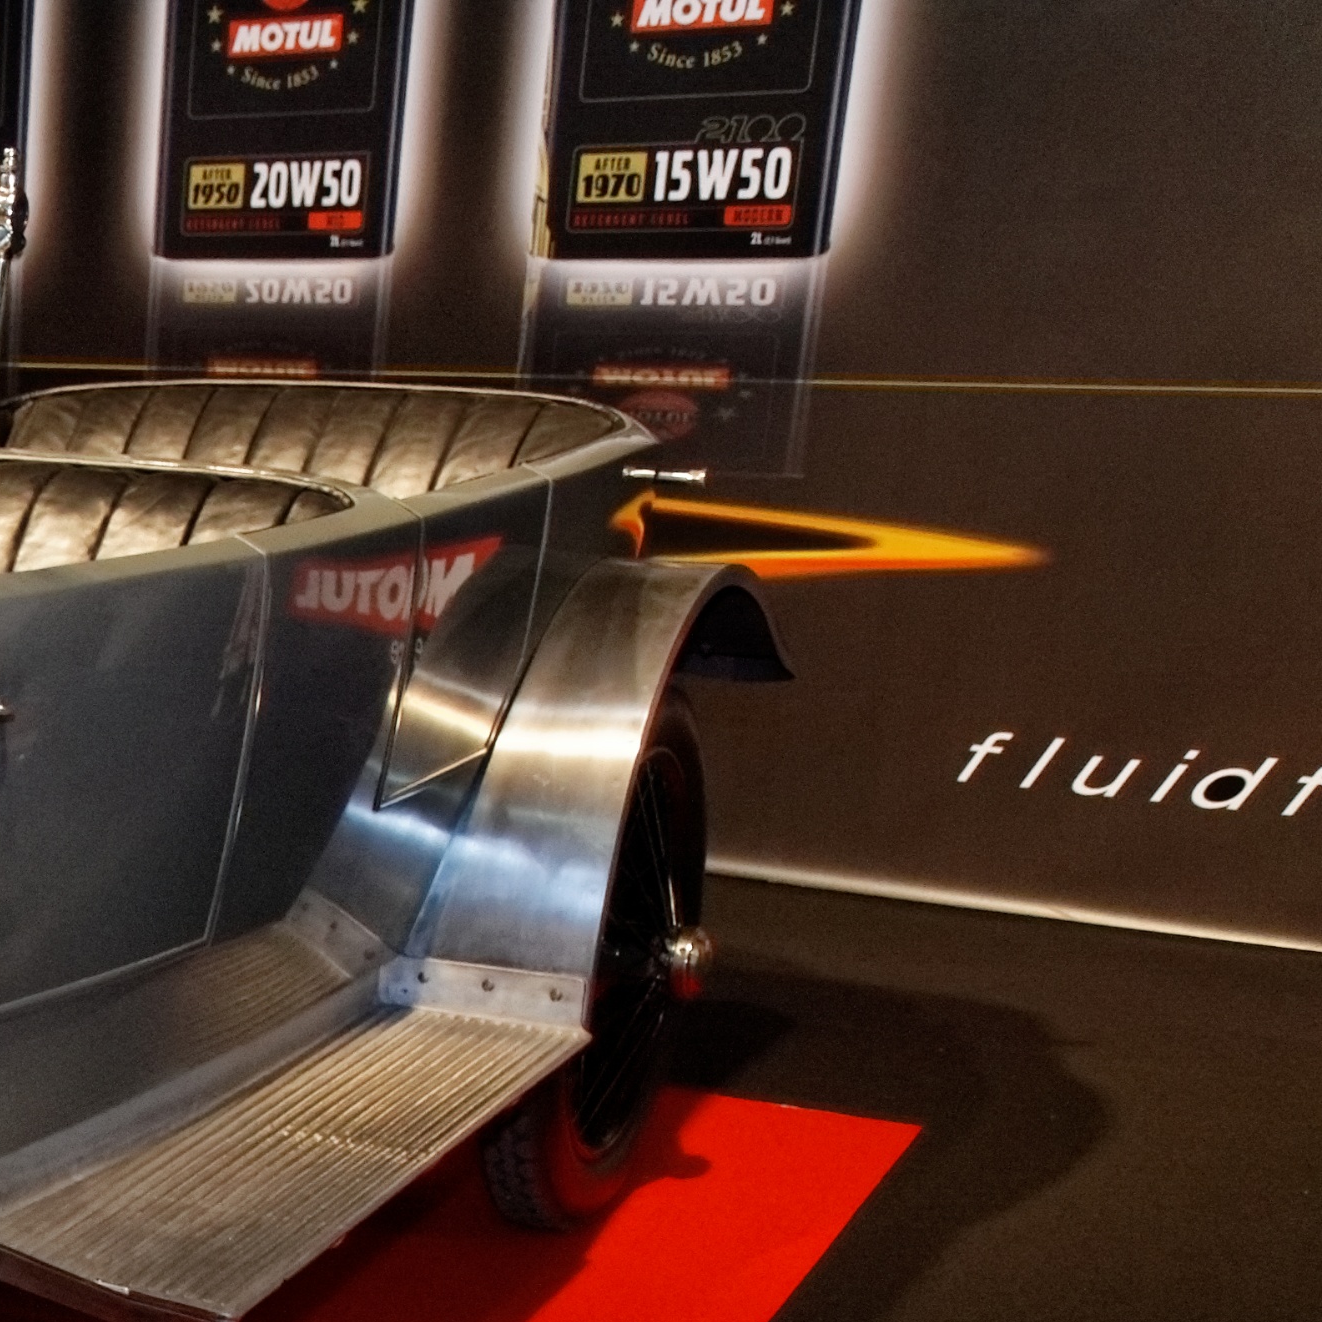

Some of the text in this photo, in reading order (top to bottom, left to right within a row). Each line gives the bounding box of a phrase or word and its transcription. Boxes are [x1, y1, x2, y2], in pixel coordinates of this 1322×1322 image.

[636, 0, 766, 28] MOTUL
[231, 19, 337, 53] MOTUL
[646, 40, 744, 69] Since 1853
[241, 64, 320, 91] Since 1853
[202, 168, 232, 181] AFTER
[594, 157, 630, 171] AFTER
[654, 147, 793, 202] 15W50
[193, 183, 240, 205] 1950
[250, 159, 362, 209] 20W50
[583, 174, 641, 198] 1970
